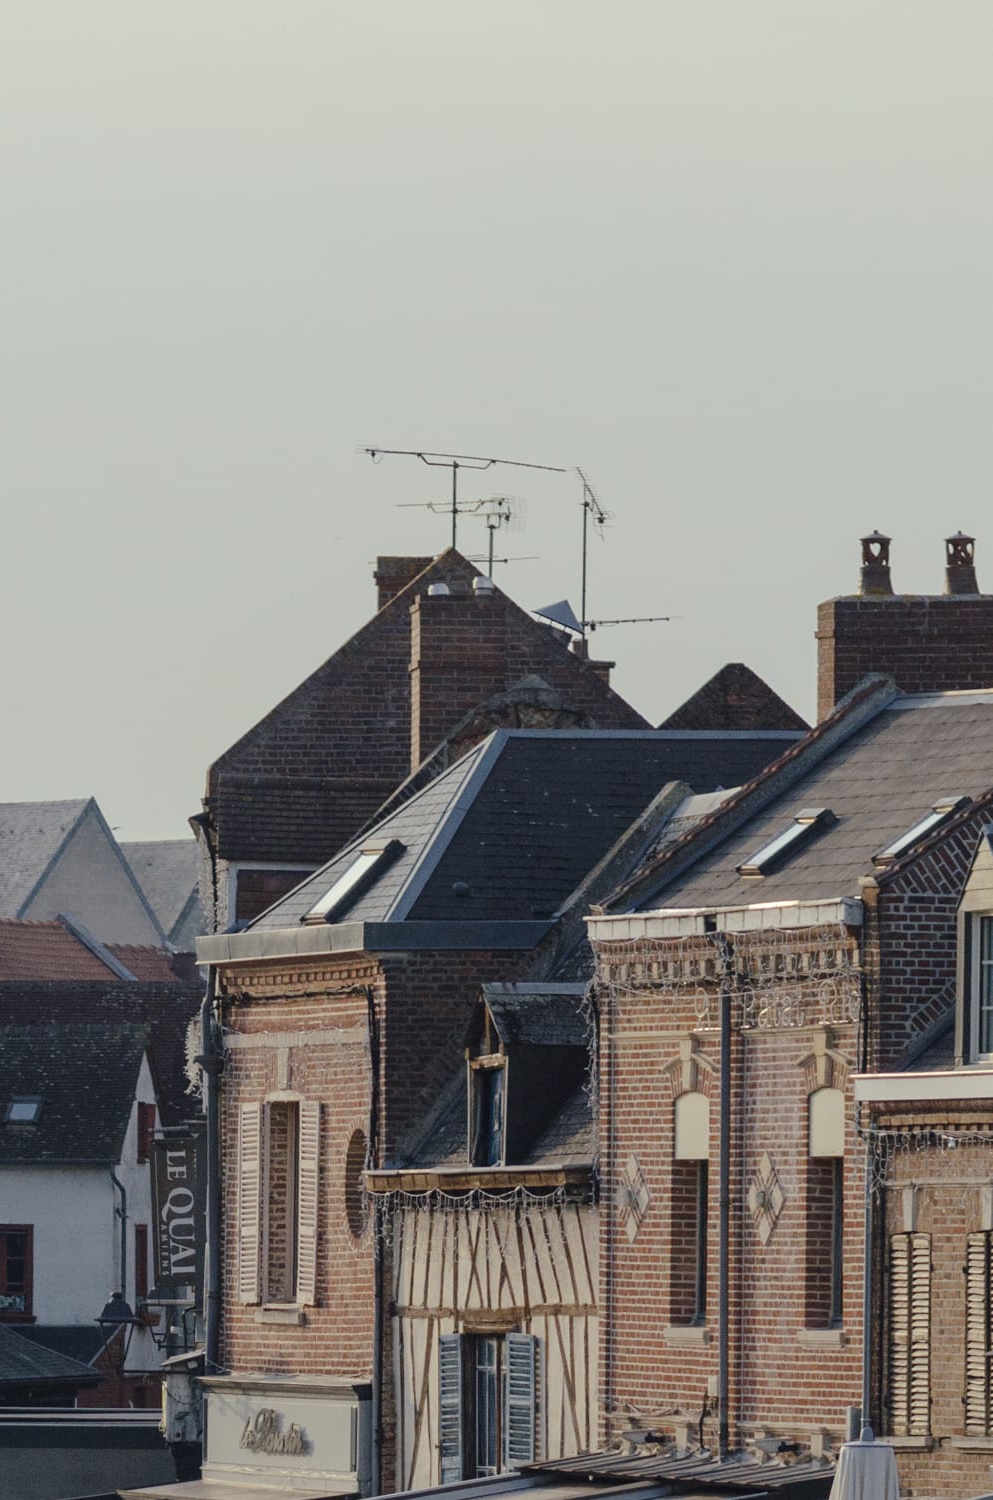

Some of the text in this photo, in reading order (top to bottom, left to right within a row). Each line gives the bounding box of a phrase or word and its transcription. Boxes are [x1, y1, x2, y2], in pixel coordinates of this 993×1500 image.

[161, 1150, 196, 1276] LE QUAI
[161, 1224, 170, 1276] AMIENS
